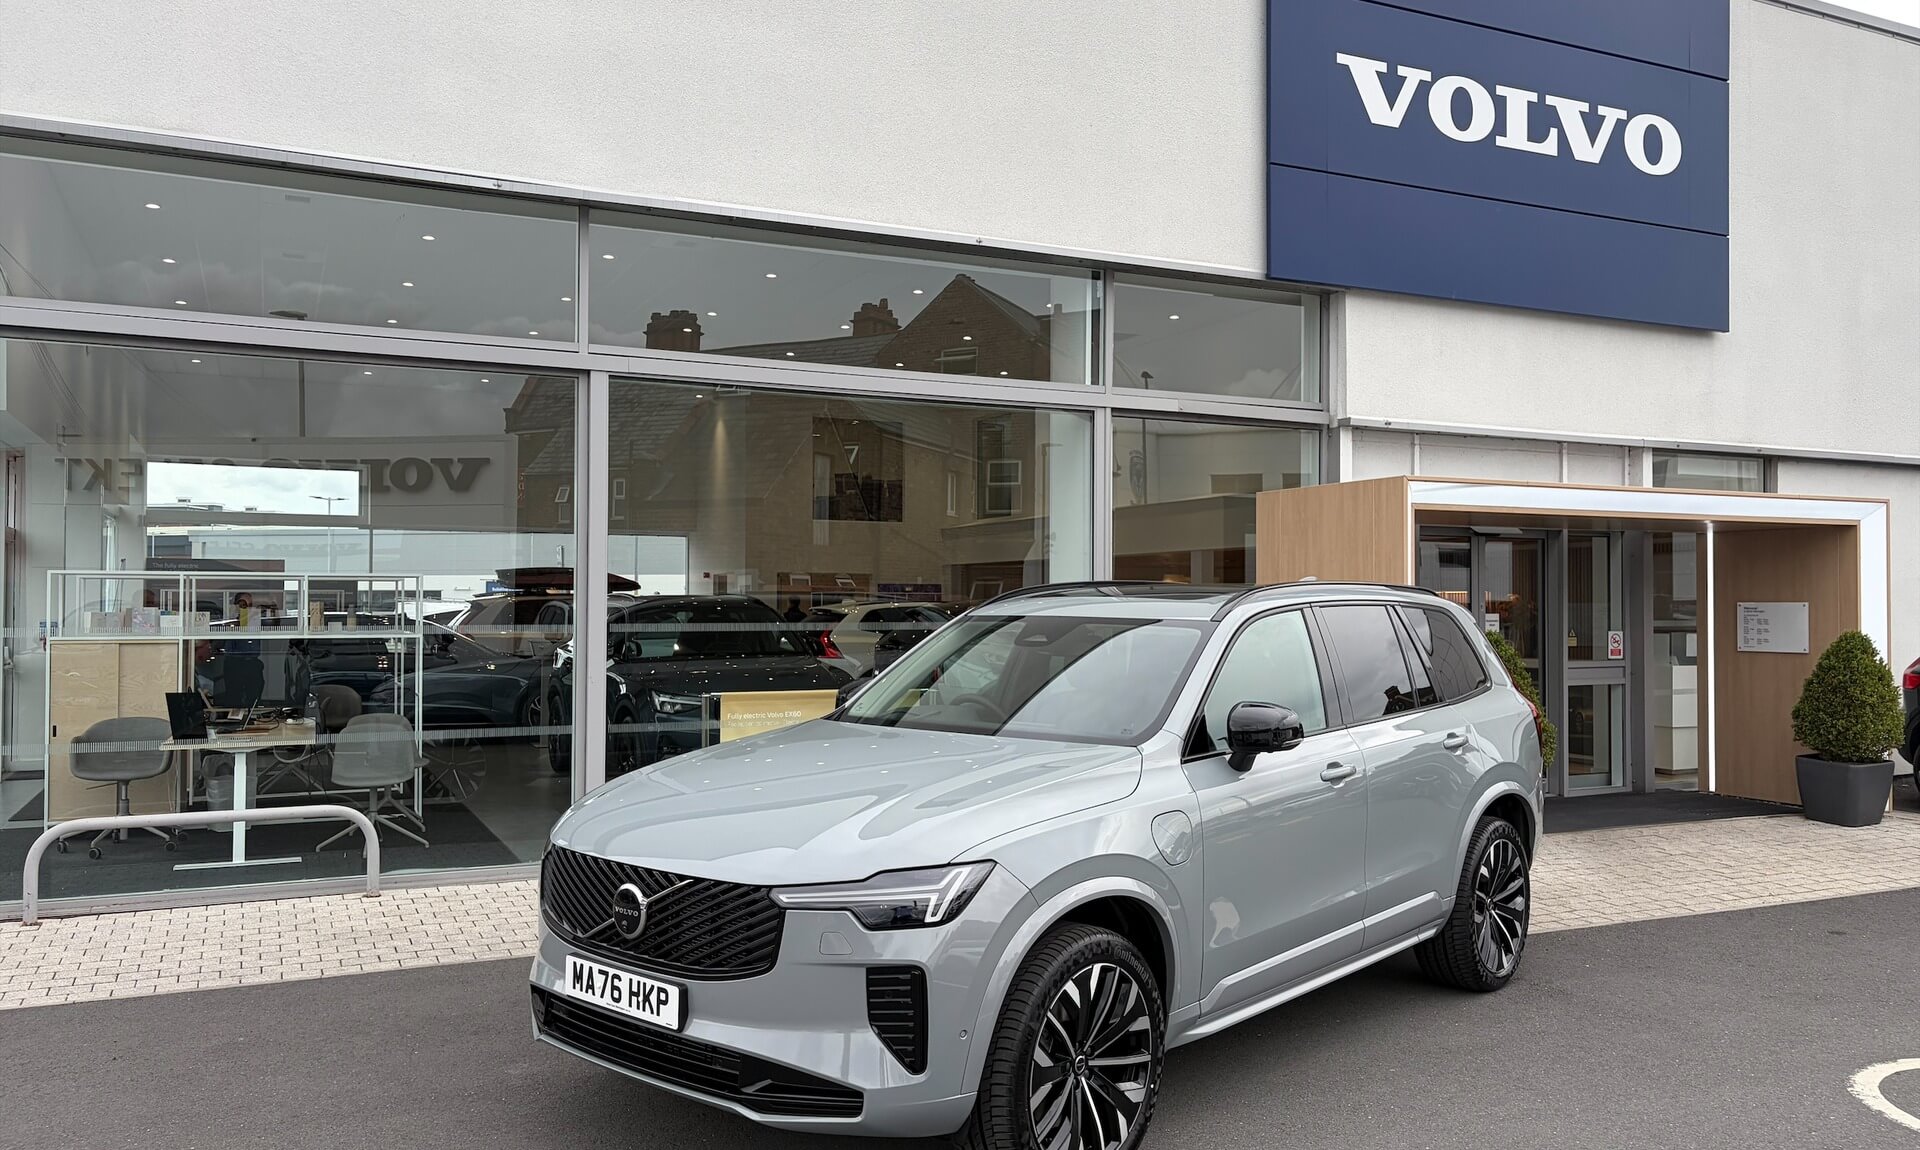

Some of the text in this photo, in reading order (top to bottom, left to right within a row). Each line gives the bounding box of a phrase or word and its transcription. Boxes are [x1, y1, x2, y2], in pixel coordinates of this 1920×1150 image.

[1336, 52, 1683, 176] VOLVO
[727, 712, 742, 720] Fully
[743, 711, 766, 719] electric
[614, 905, 639, 917] VOLVO
[1114, 945, 1150, 983] Continental
[572, 961, 669, 1017] MA76 HKP
